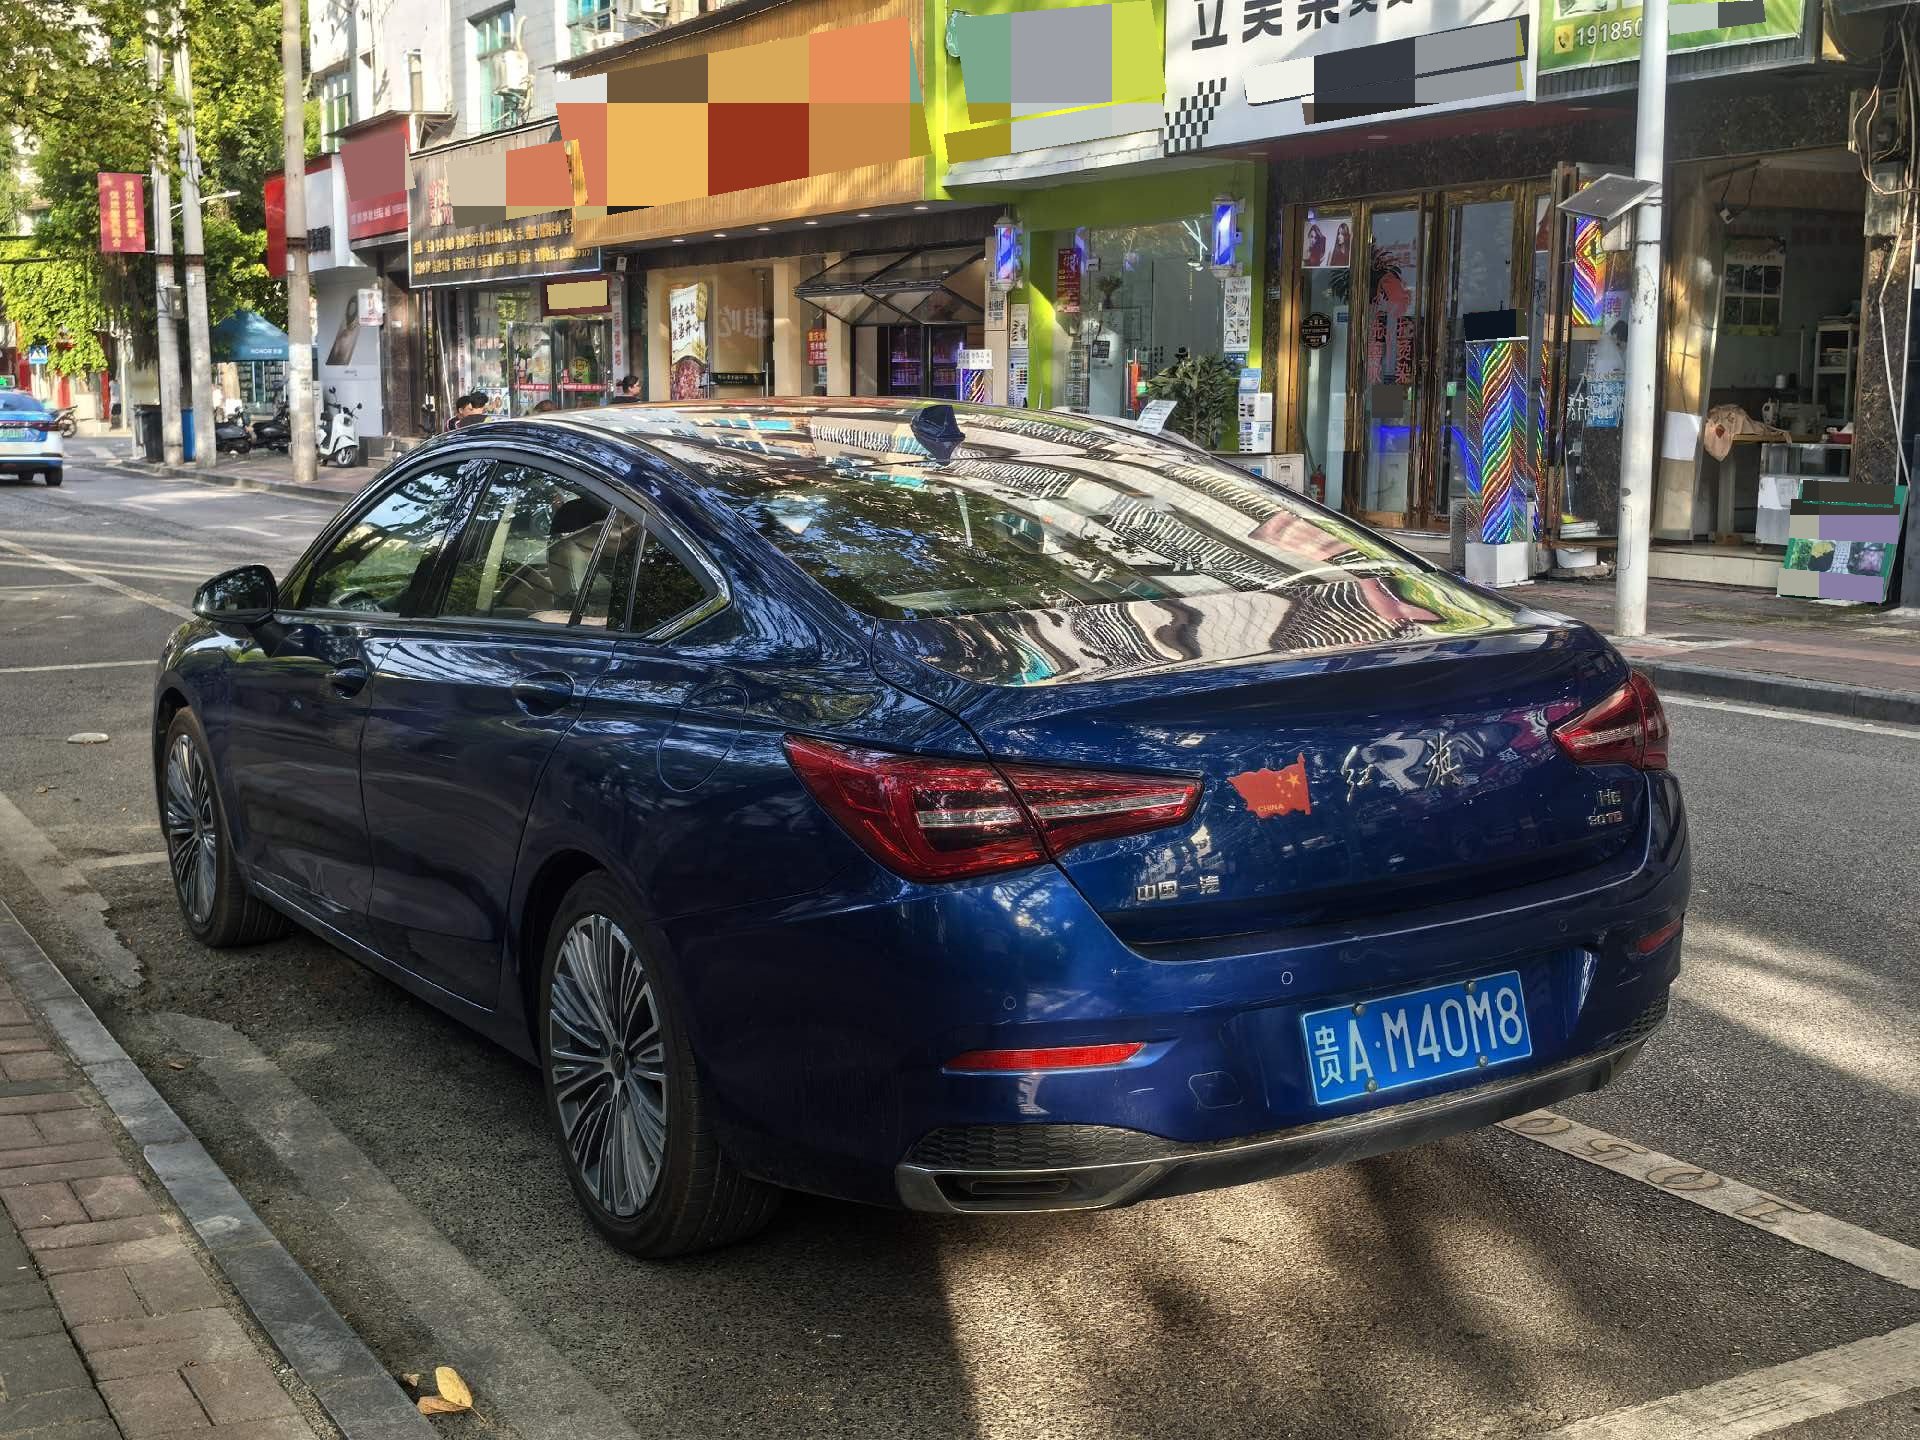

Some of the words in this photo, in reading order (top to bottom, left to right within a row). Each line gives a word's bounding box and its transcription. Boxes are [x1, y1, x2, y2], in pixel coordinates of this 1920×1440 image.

[1257, 803, 1284, 813] CHINA
[1137, 875, 1220, 901] 中国一汽
